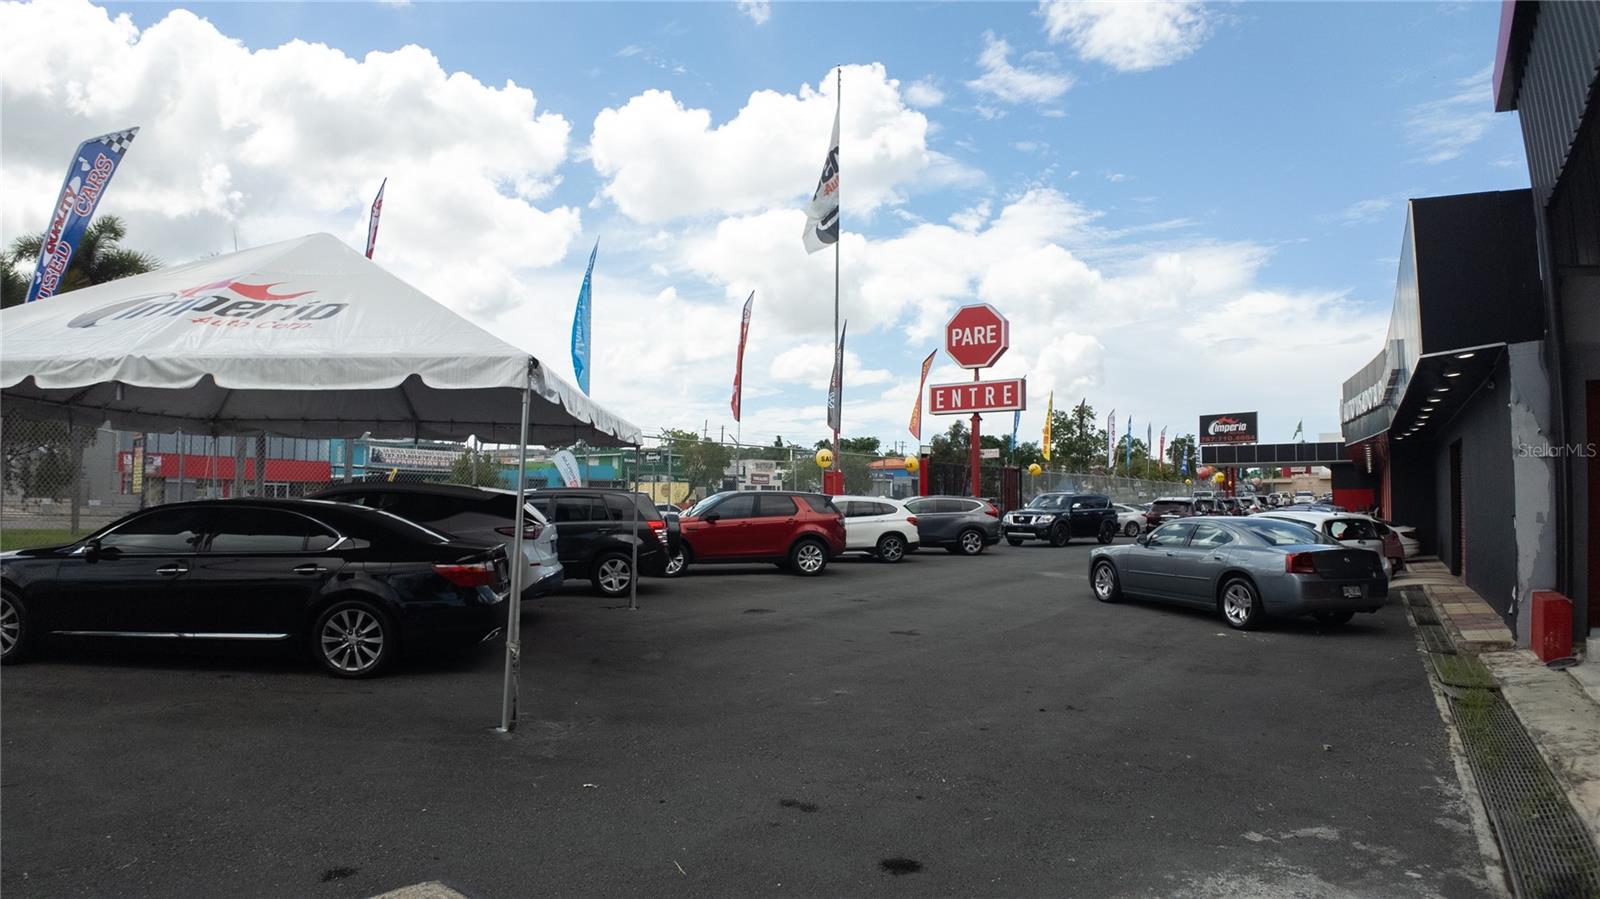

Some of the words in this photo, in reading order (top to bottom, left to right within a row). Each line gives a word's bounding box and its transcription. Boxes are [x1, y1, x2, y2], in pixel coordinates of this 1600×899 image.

[73, 152, 116, 218] CARS
[45, 183, 77, 255] QUALITY
[35, 240, 73, 300] USED
[951, 324, 998, 348] PARE
[935, 384, 1013, 410] ENTRE
[820, 455, 833, 463] SAL
